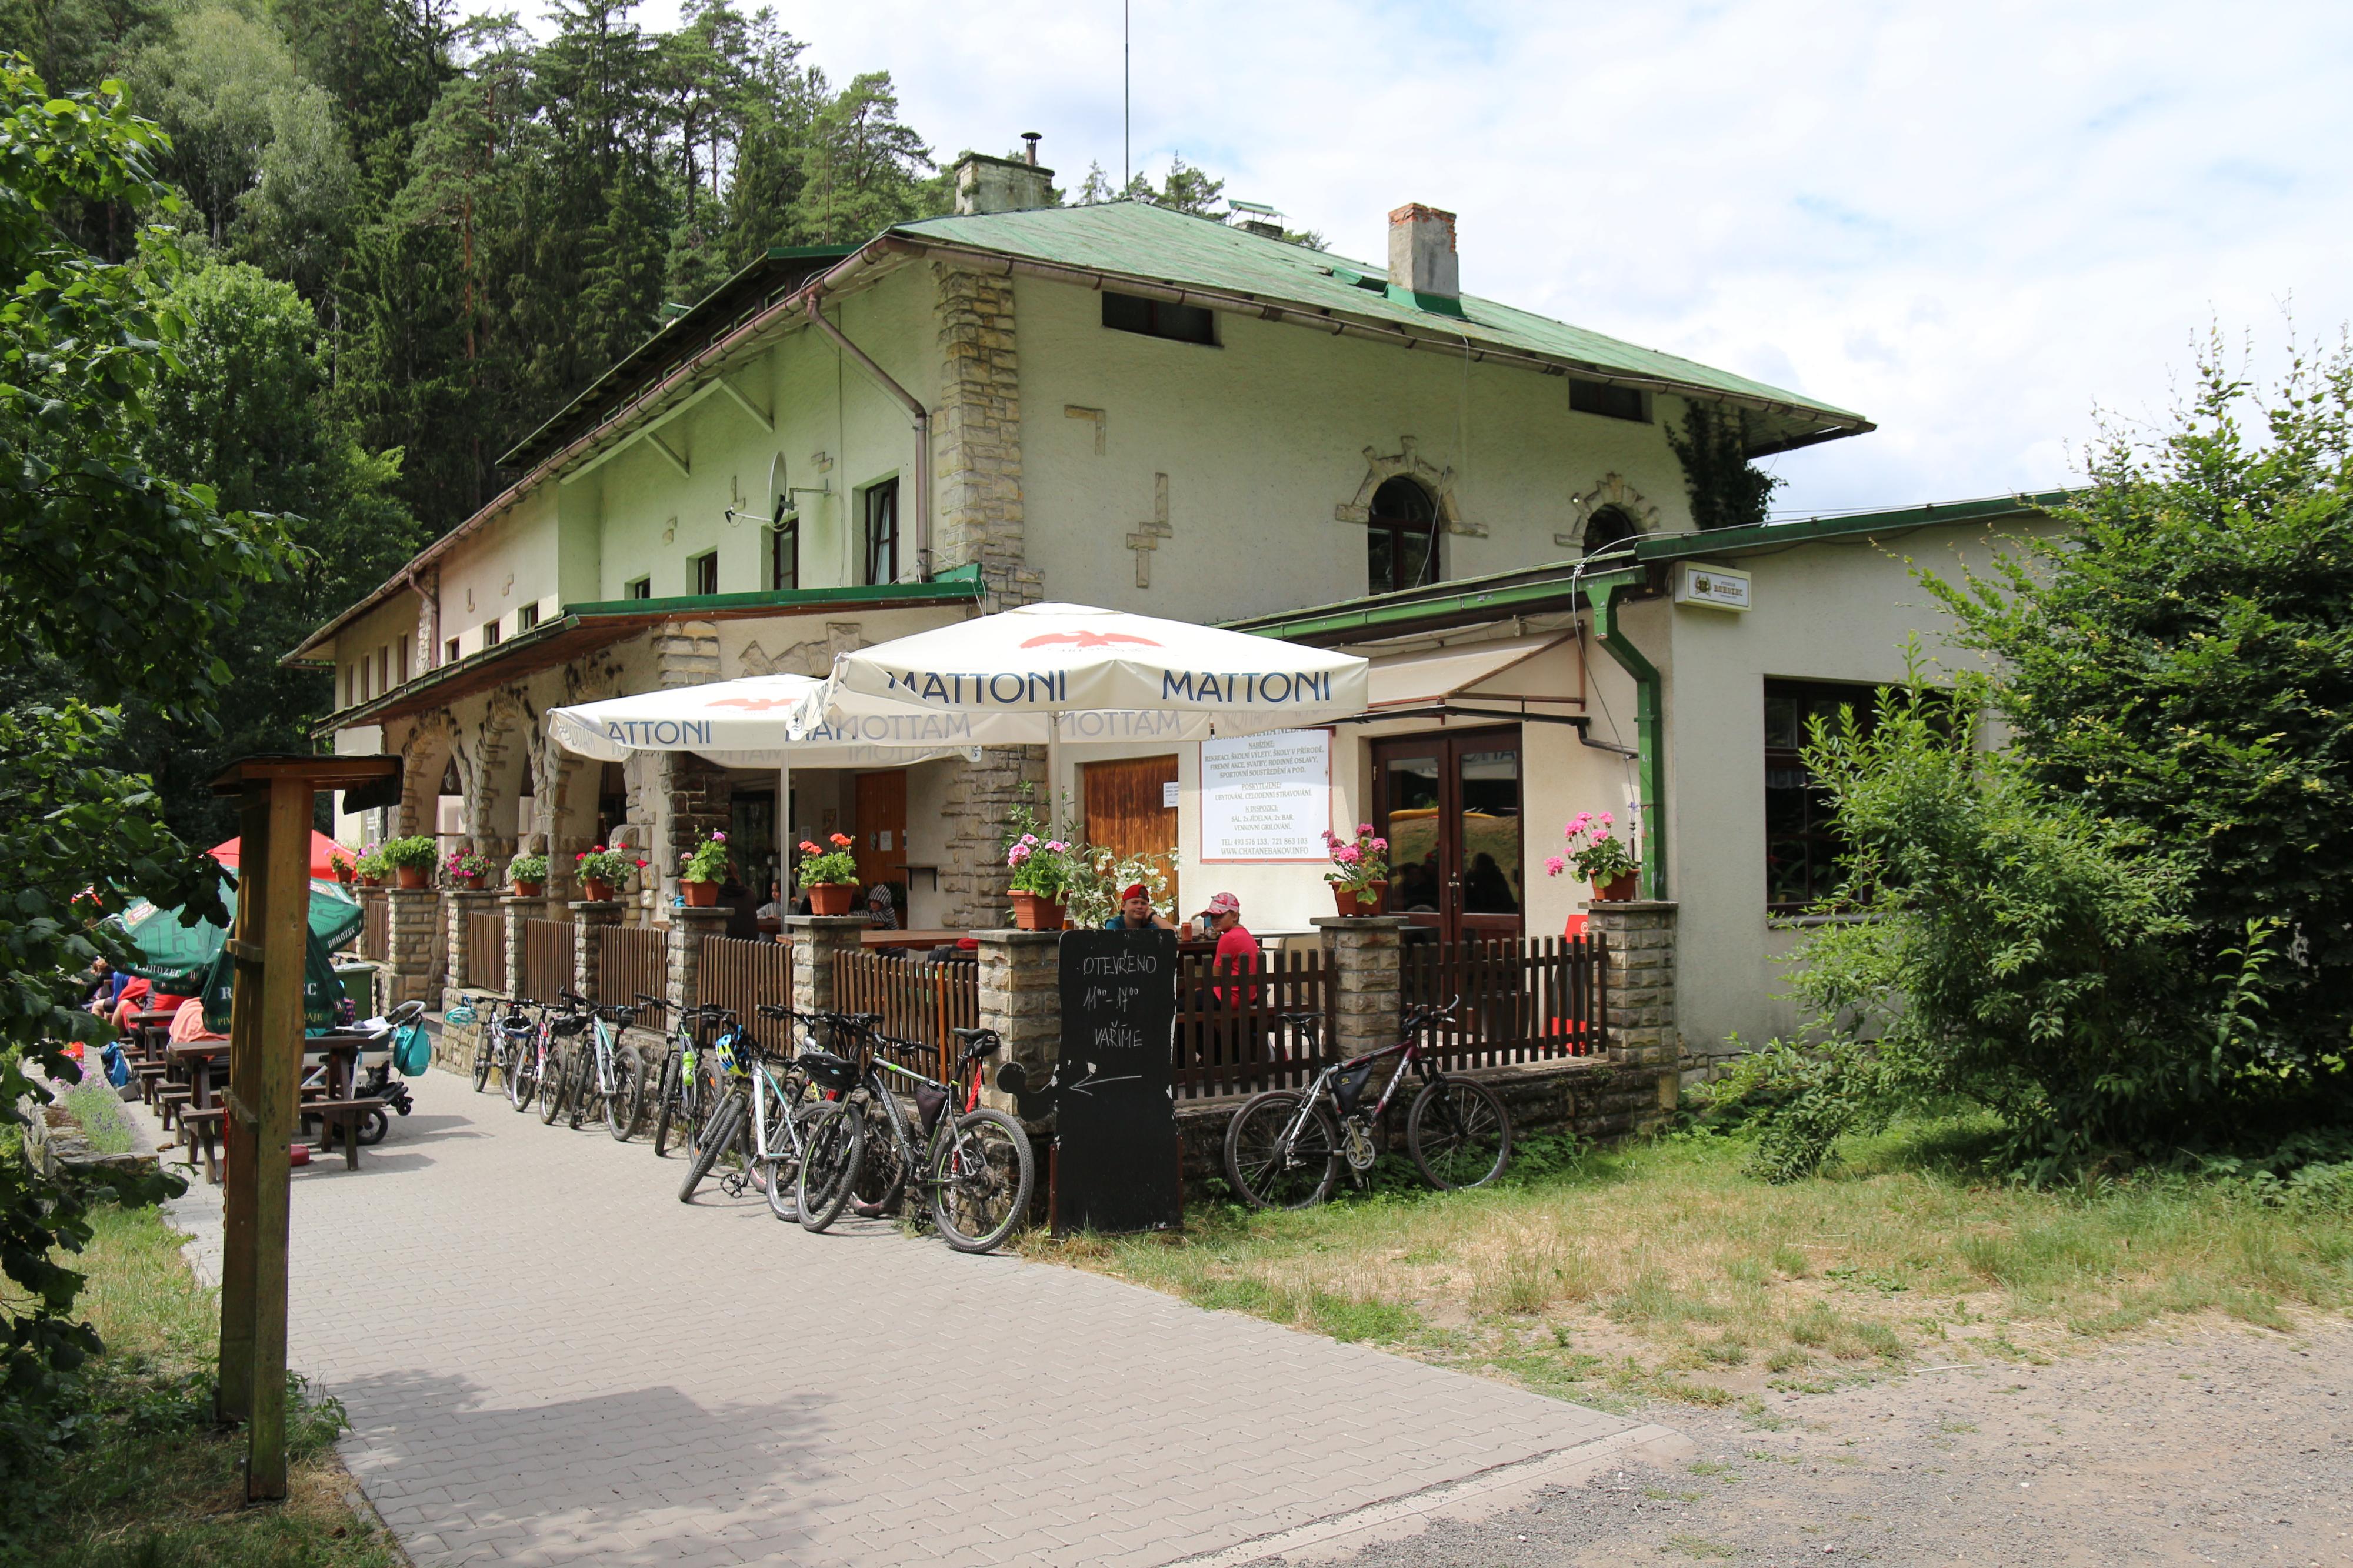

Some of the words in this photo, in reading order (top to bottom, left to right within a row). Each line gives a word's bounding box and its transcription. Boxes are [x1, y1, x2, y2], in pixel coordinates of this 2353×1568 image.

[1162, 669, 1330, 702] MATTONI
[608, 720, 711, 745] ATTONI
[1084, 949, 1156, 975] OTEVŘENO
